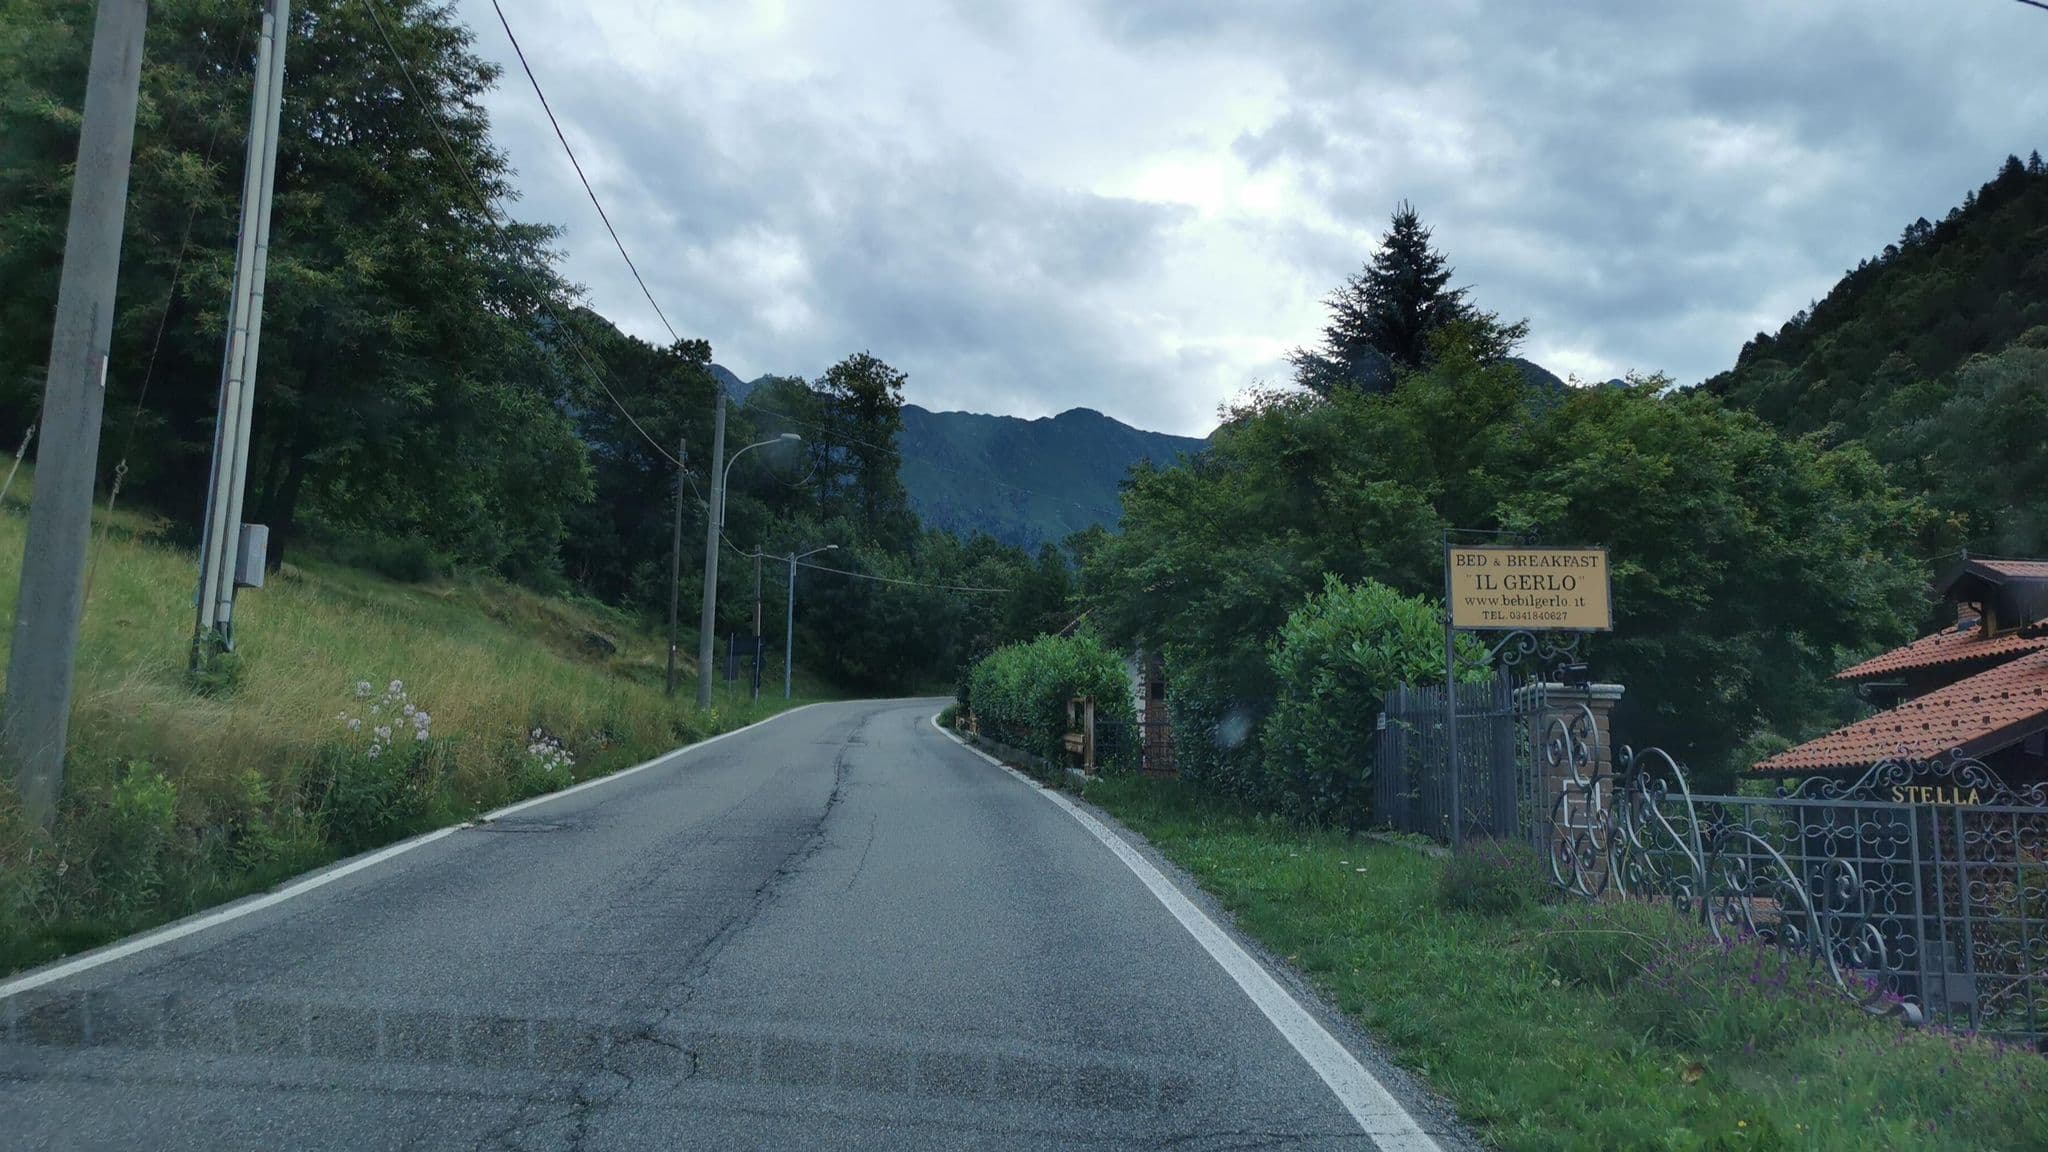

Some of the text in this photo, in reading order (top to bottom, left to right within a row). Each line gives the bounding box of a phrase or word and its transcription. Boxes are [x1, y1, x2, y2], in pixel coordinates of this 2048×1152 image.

[1456, 554, 1598, 568] BED & BREAKFAST
[1891, 785, 1980, 805] STELLA
